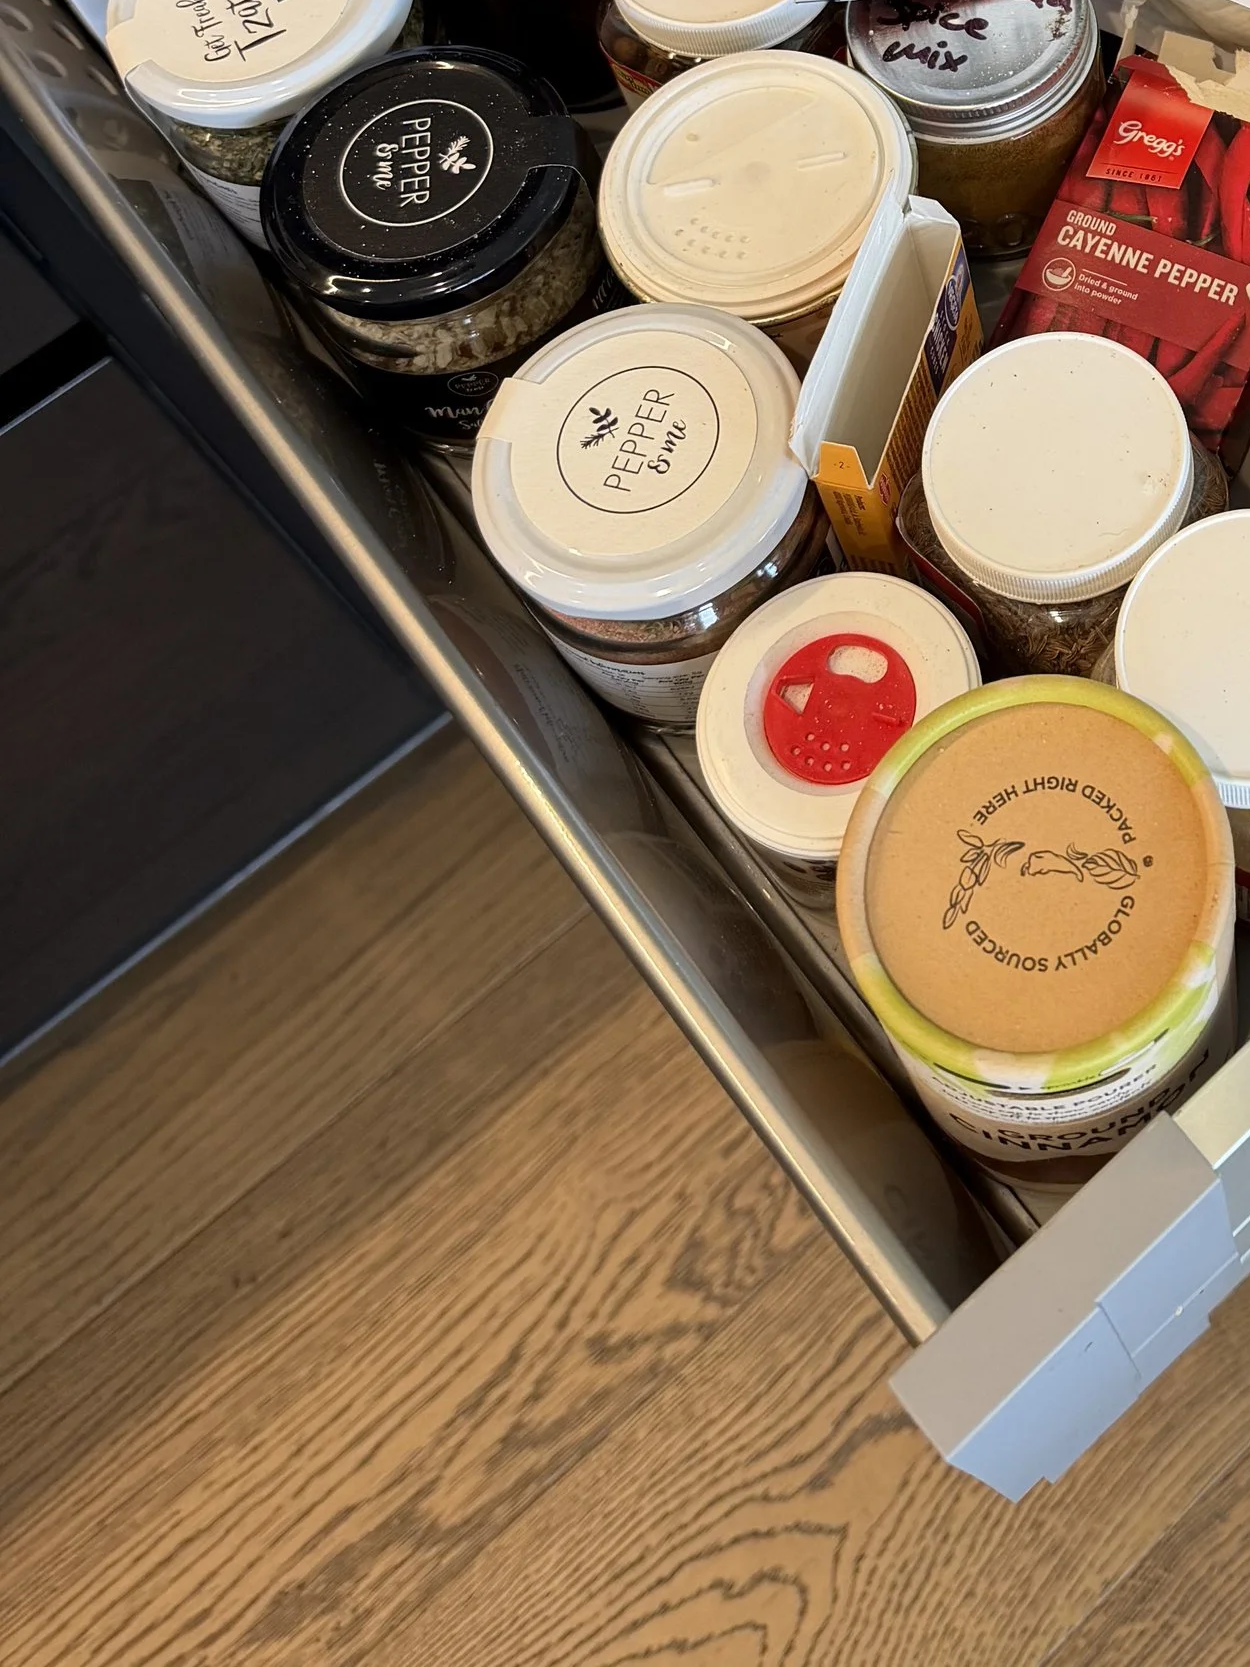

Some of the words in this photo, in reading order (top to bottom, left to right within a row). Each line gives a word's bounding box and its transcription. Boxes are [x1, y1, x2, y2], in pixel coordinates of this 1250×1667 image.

[204, 34, 232, 62] Get
[882, 40, 969, 73] mix
[1114, 121, 1185, 157] Gregg's
[400, 117, 432, 208] PEPPER
[1105, 168, 1134, 177] SINCE
[1138, 173, 1161, 181] 1861
[1064, 207, 1118, 239] GROUND
[1054, 221, 1155, 276] CAYENNE
[1152, 256, 1241, 307] PEPPER
[1074, 283, 1091, 295] into
[1090, 290, 1122, 304] powder
[1077, 272, 1101, 288] Dried
[1099, 280, 1109, 290] &
[1109, 286, 1138, 300] ground
[603, 389, 675, 492] PEPPER
[1022, 776, 1079, 795] RIGHT
[973, 785, 1019, 826] HERE
[1081, 784, 1136, 845] PACKED
[965, 920, 1049, 973] SOURCED
[1055, 895, 1136, 972] GLOBALLY
[998, 1087, 1171, 1142] GROUND
